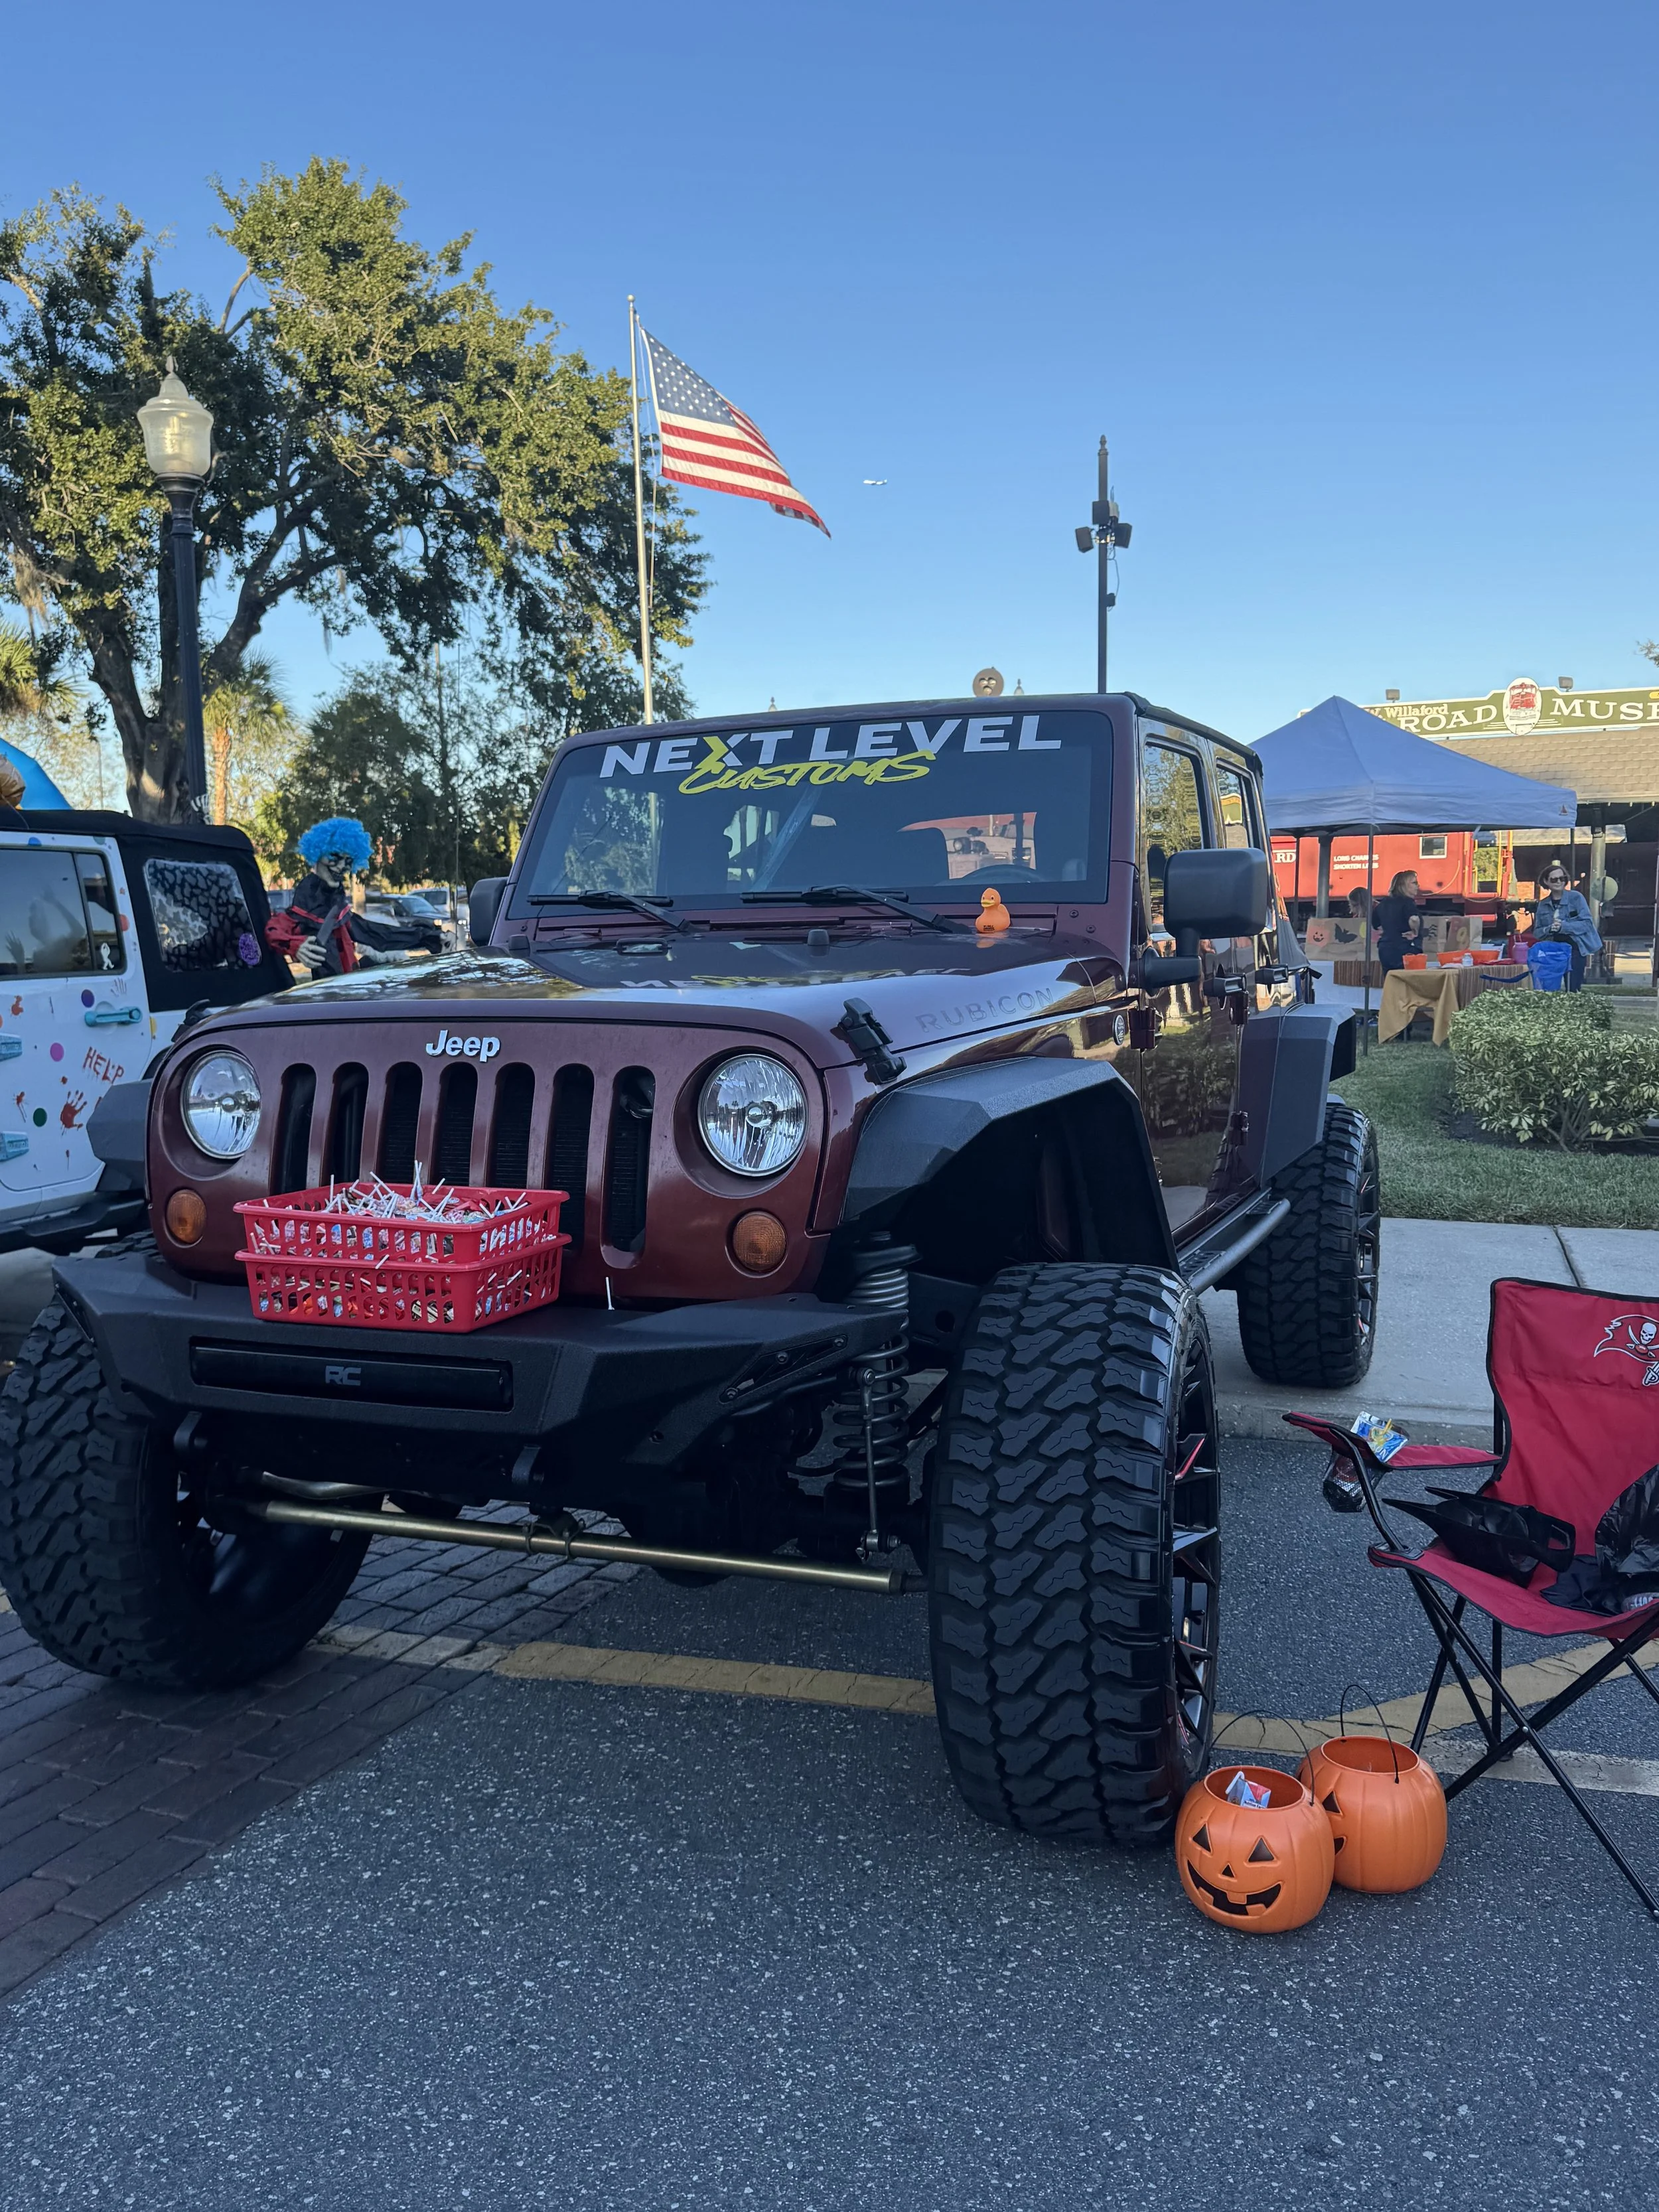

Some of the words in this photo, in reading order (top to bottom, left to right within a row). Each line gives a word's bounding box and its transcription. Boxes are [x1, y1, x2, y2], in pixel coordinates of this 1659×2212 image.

[1384, 703, 1449, 718] Willaford
[599, 730, 793, 778] NEXT
[809, 715, 1061, 762] LEVEL
[915, 988, 1054, 1033] RUBICON
[425, 1029, 500, 1062] Jeep
[83, 1046, 124, 1084] HELP
[325, 1365, 362, 1386] RC
